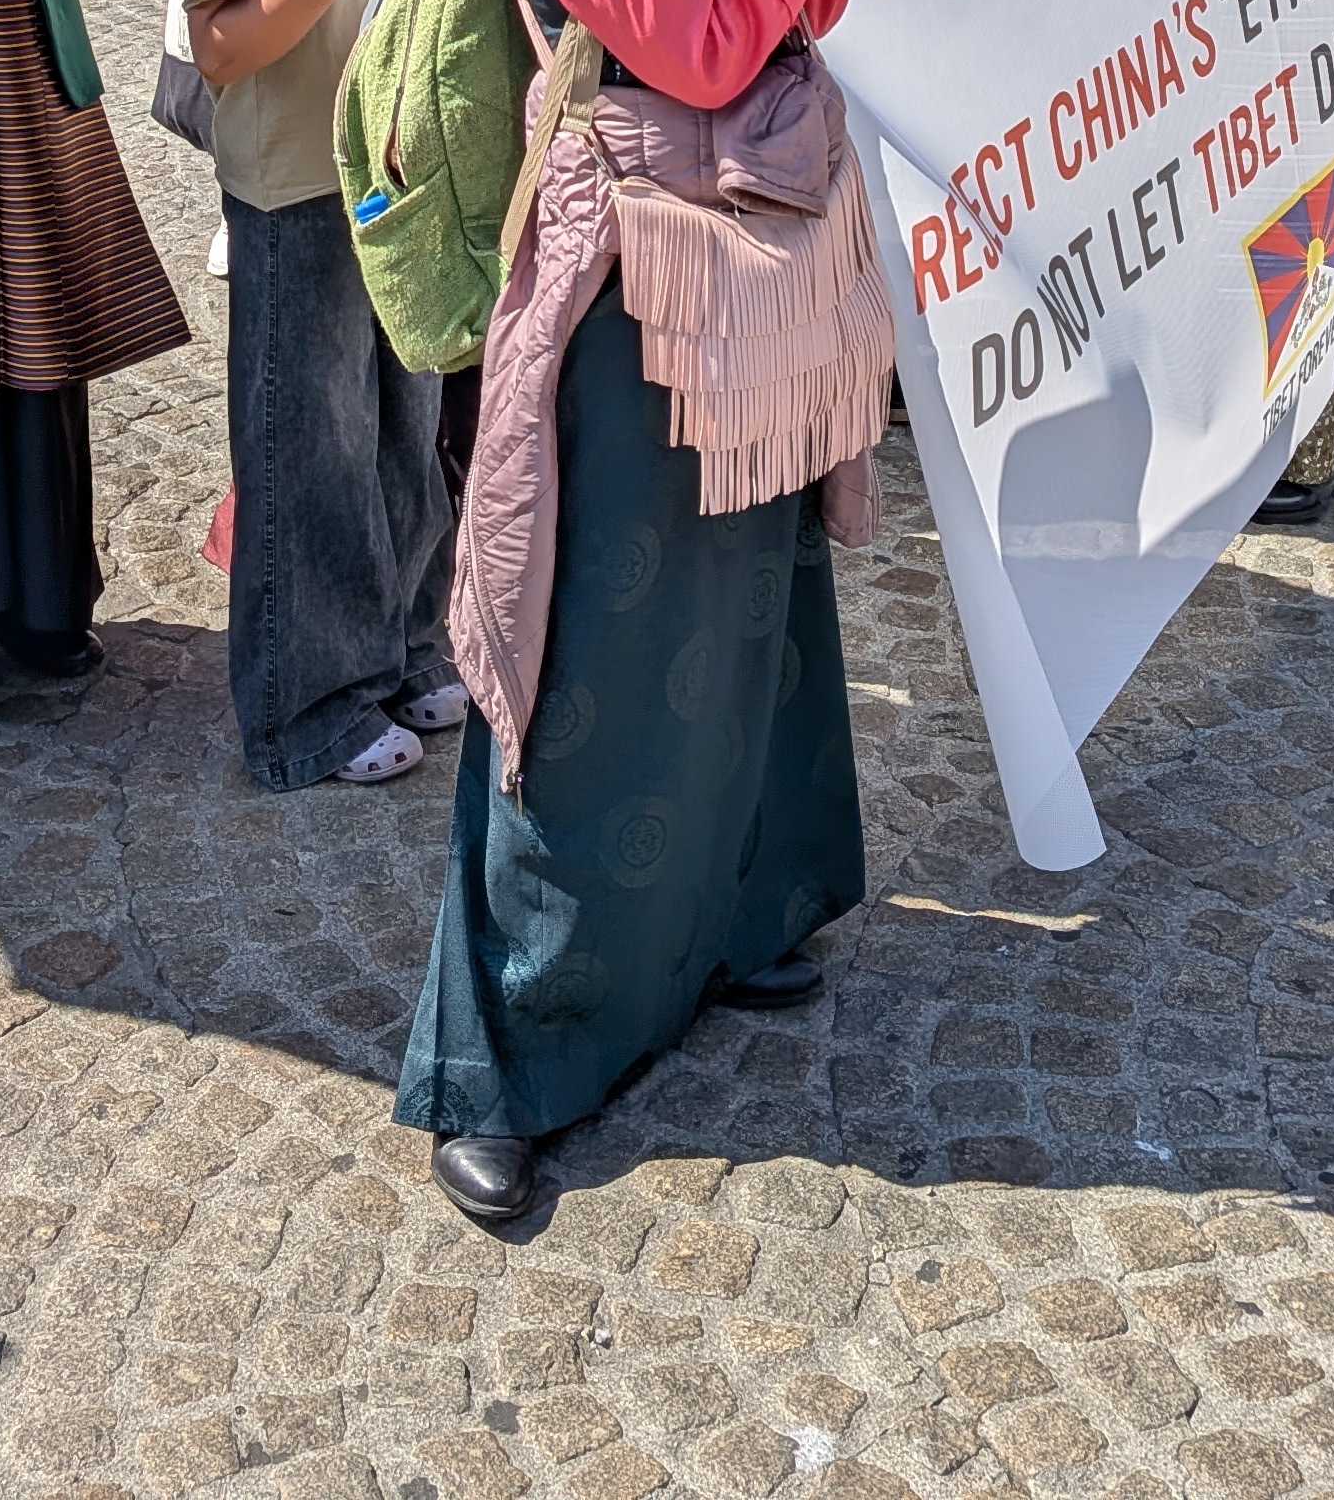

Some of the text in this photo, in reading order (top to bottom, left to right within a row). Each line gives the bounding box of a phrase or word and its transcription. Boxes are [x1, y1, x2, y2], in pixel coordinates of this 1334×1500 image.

[972, 307, 1045, 429] DO
[1037, 226, 1106, 374] NOT
[1107, 156, 1185, 292] LET
[1192, 63, 1300, 215] TIBET
[1261, 371, 1299, 445] TIBET
